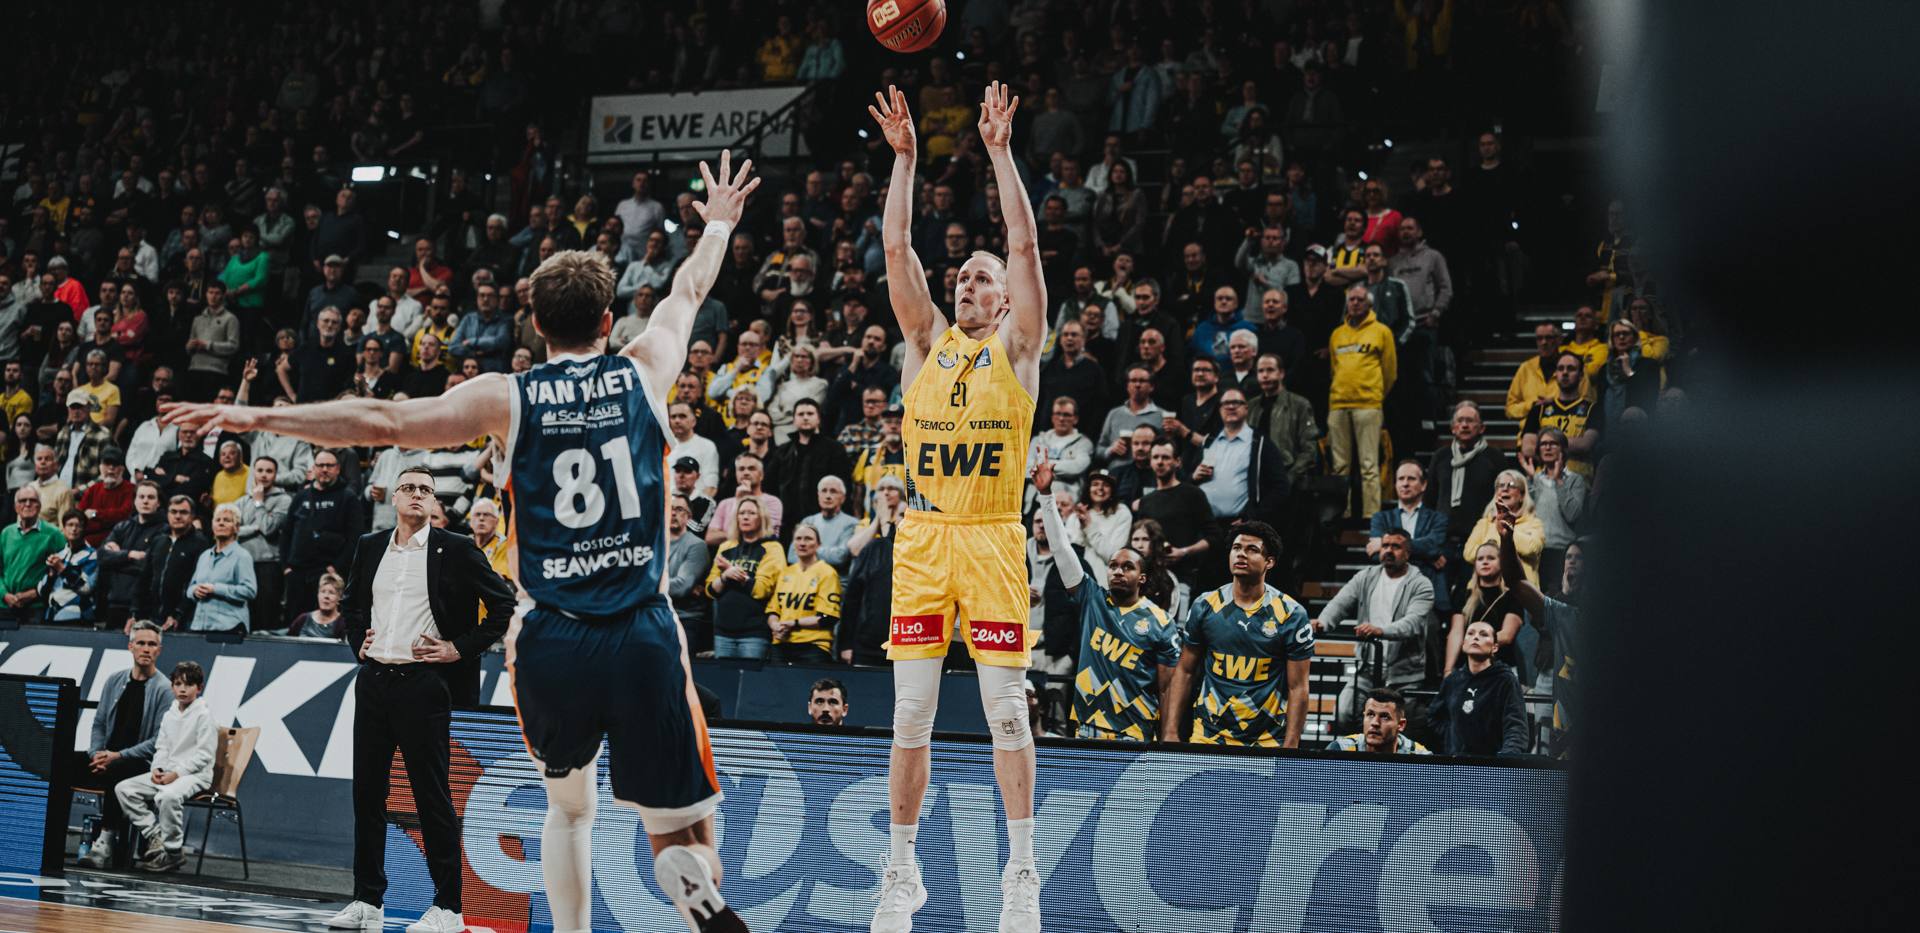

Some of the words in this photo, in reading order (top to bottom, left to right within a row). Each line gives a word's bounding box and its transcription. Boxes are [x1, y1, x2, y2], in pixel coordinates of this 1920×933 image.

[639, 112, 704, 141] EWE
[526, 379, 576, 405] VAN
[950, 381, 967, 408] 21
[920, 419, 955, 432] SEMCO
[969, 418, 1013, 430] VIEROL
[917, 442, 1004, 477] EWE
[552, 435, 642, 529] 81
[573, 532, 630, 553] ROSTOCK
[776, 592, 817, 611] EWE
[970, 627, 1017, 644] cewe
[1090, 626, 1144, 670] EWE
[1212, 652, 1273, 682] EWE
